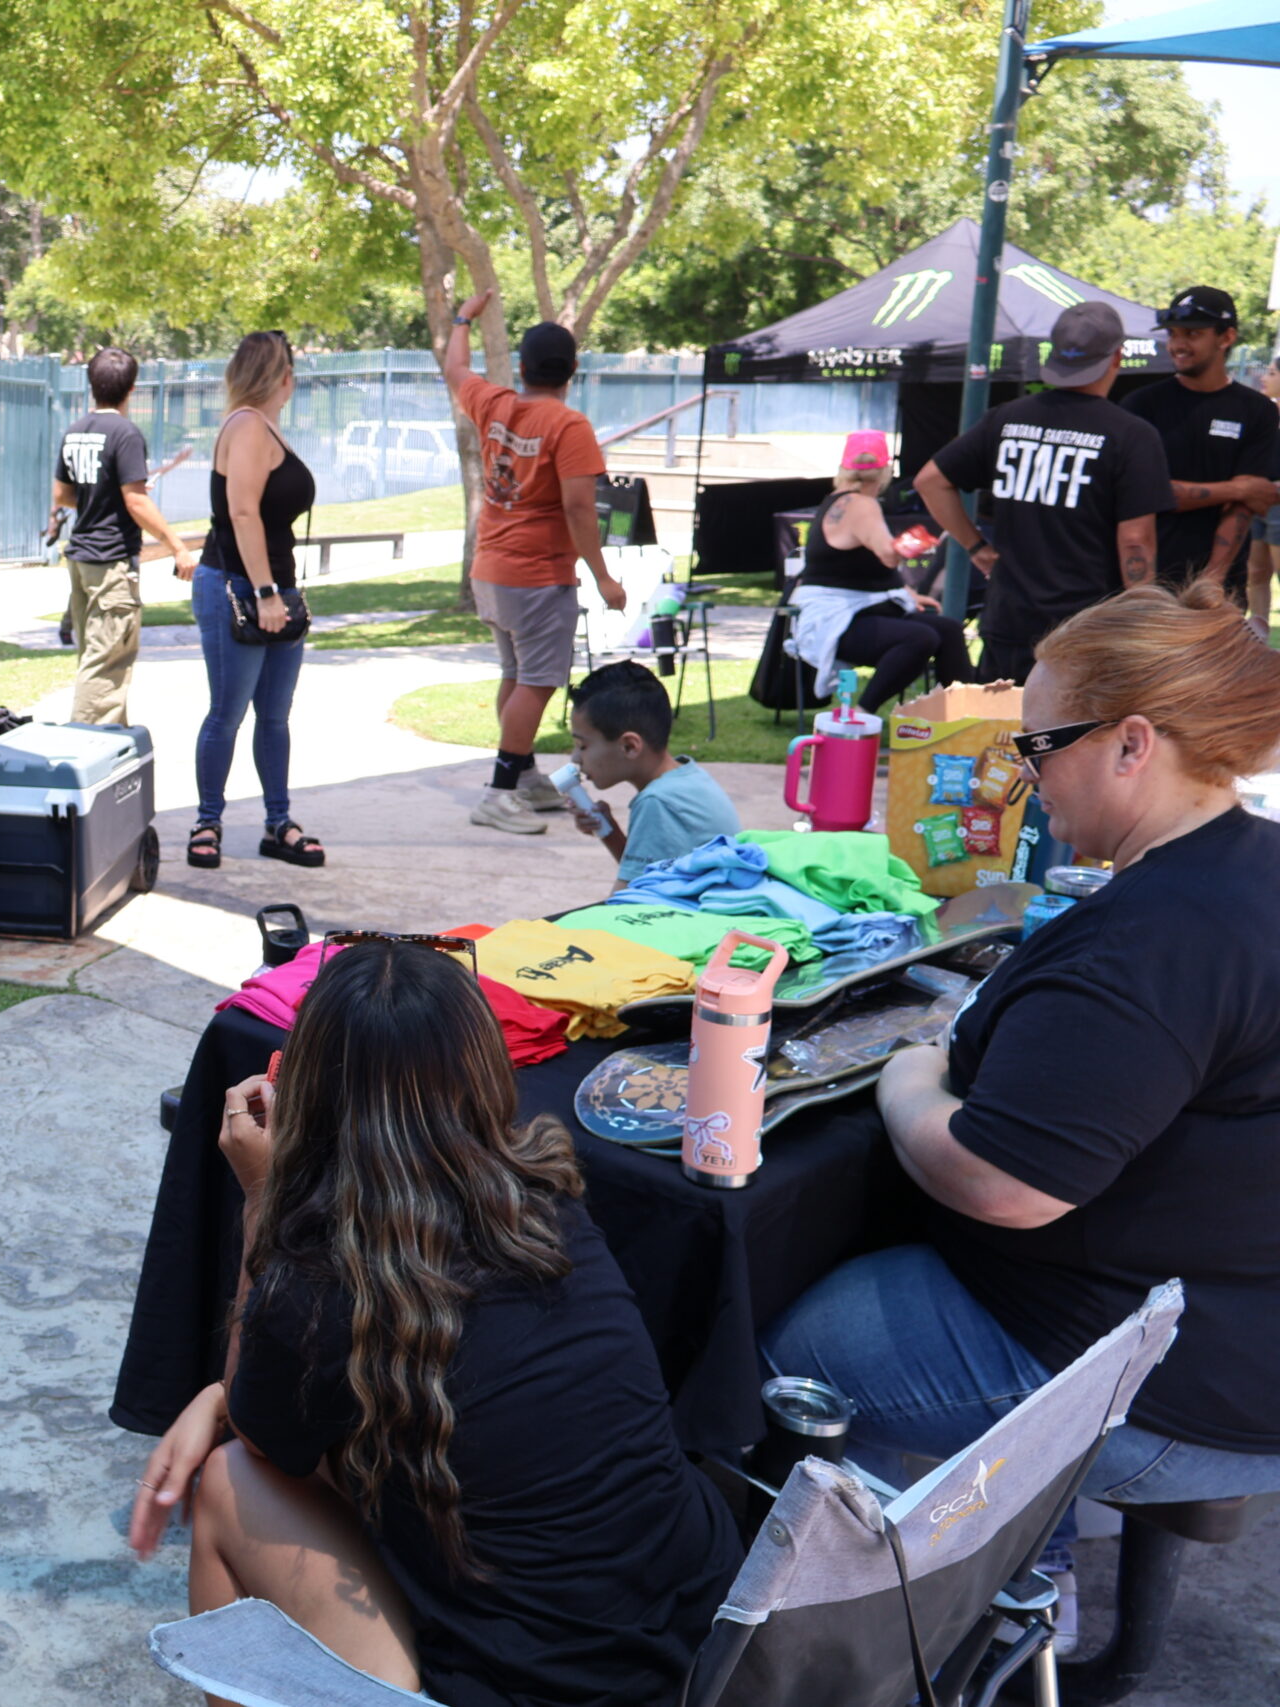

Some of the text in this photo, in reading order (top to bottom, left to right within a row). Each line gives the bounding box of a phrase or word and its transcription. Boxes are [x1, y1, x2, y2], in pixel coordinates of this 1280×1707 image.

[1000, 423, 1106, 449] FONTANA SKATEPARKS
[992, 439, 1100, 509] STAFF
[701, 1152, 733, 1167] YETI
